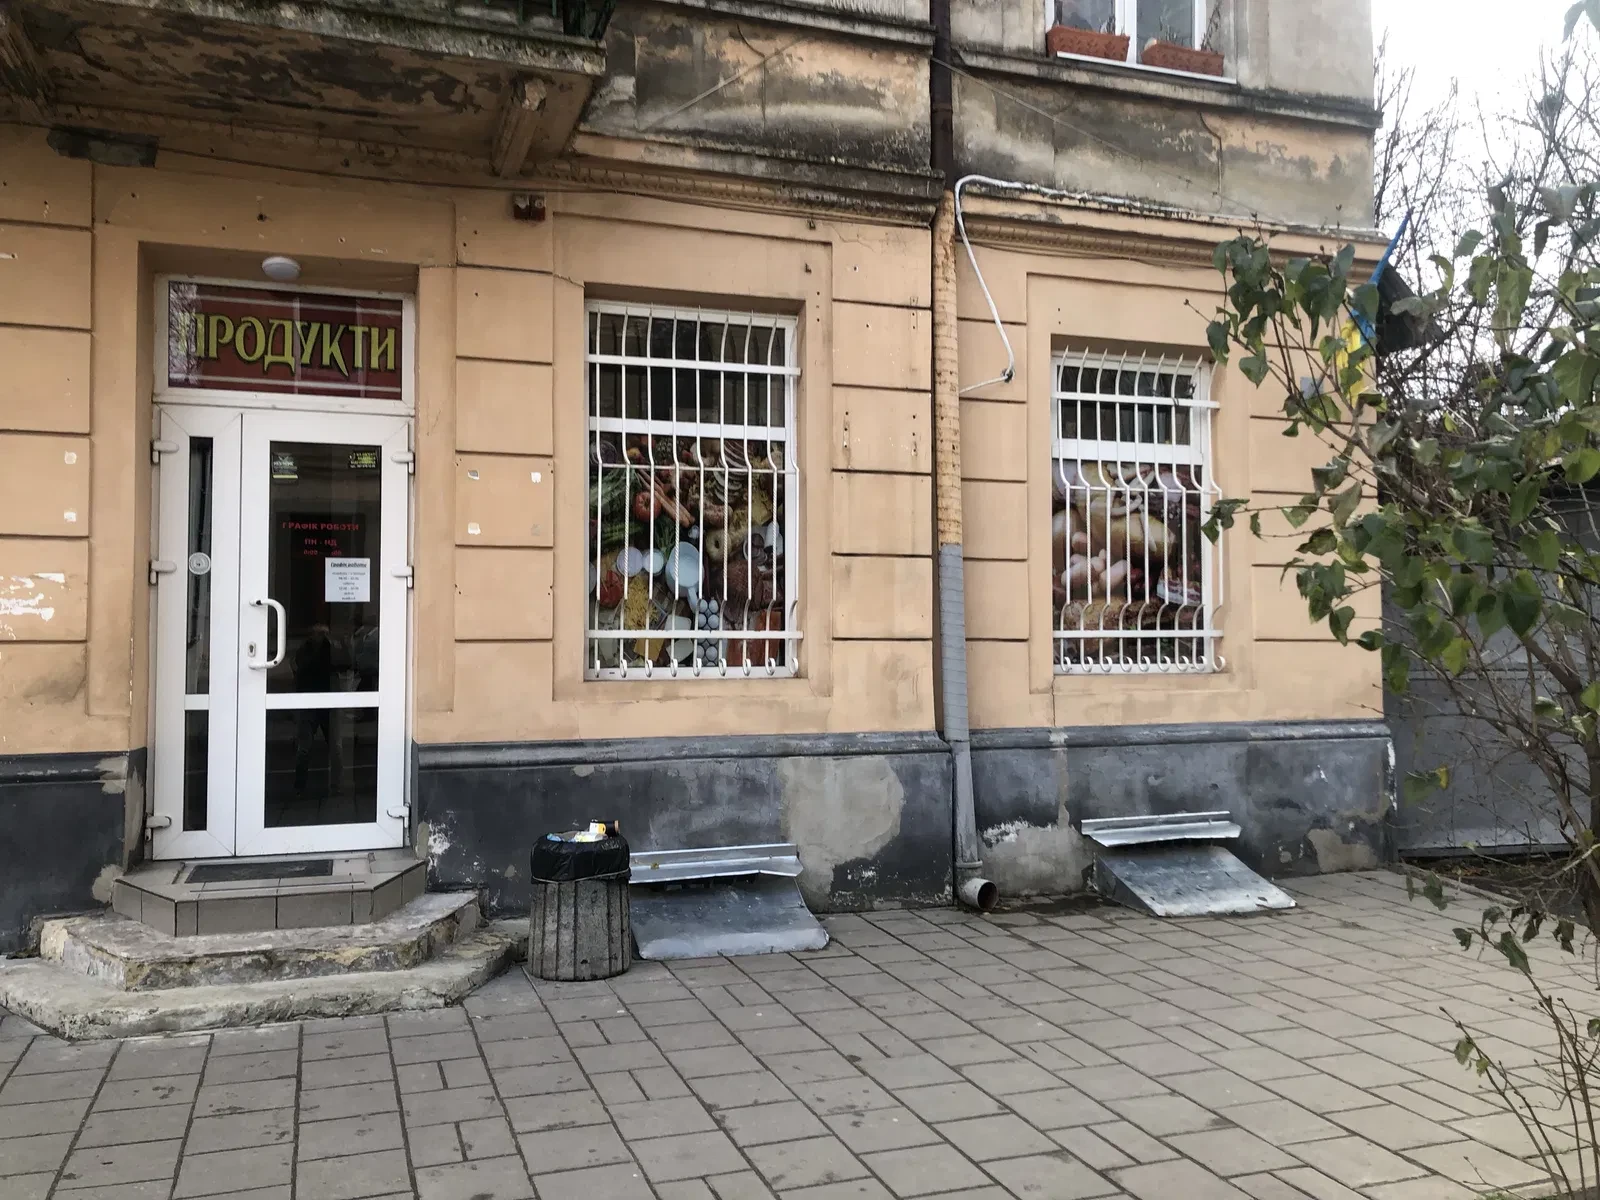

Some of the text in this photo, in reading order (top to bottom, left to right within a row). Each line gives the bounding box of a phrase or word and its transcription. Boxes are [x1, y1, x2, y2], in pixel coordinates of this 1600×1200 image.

[178, 311, 396, 377] ПРОДУКТИ
[282, 522, 359, 531] ГРАФІК РОБОТИ
